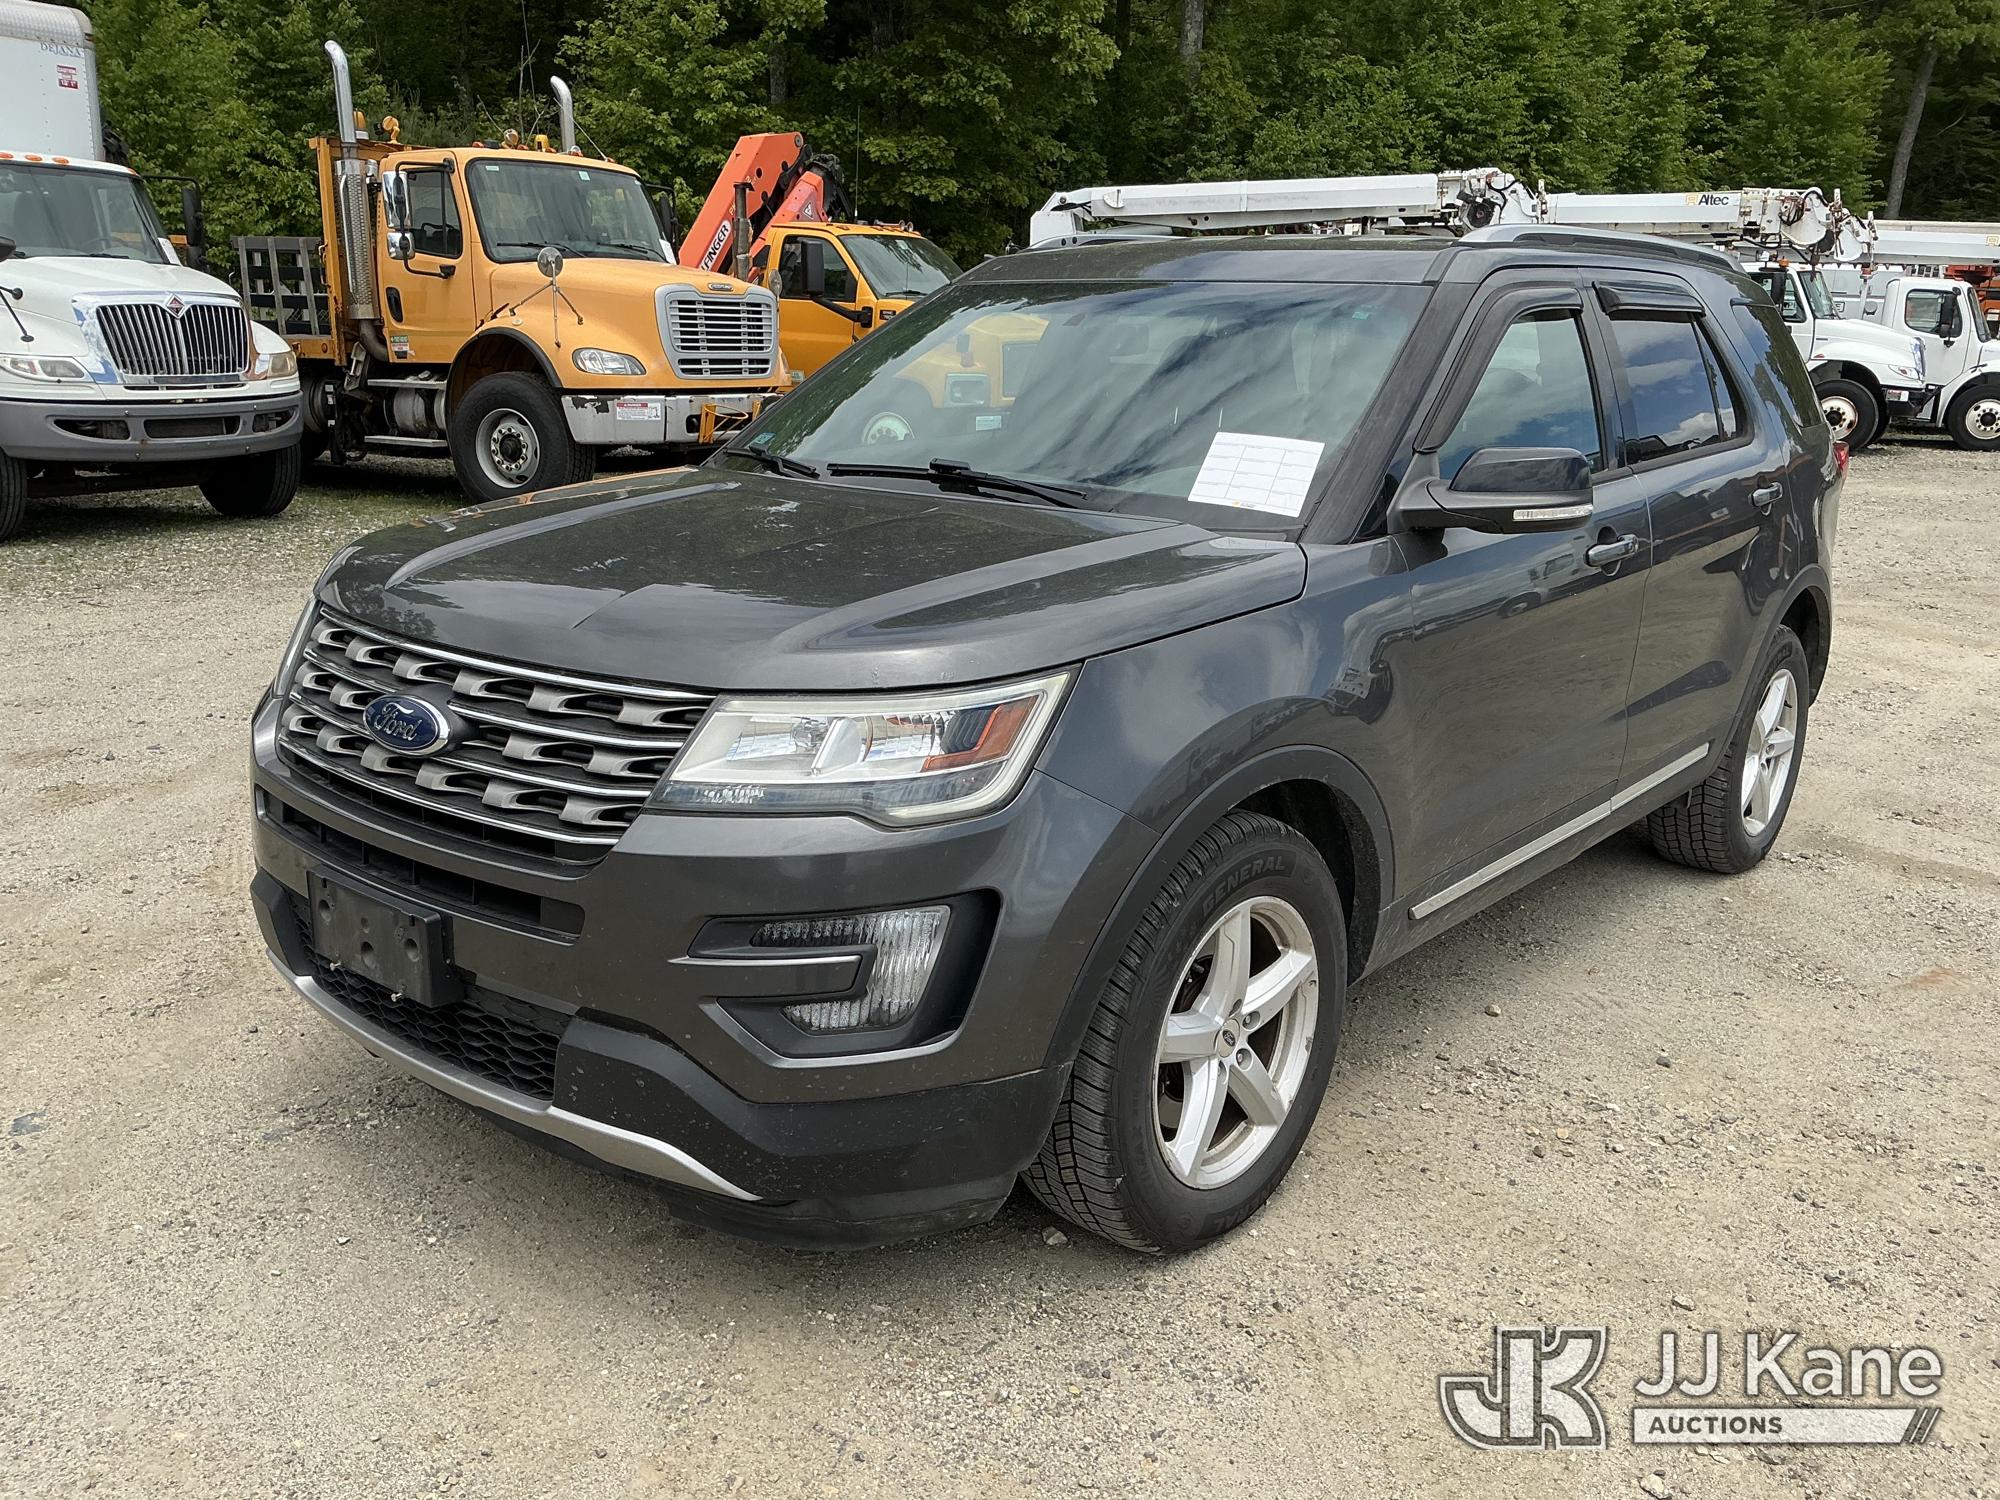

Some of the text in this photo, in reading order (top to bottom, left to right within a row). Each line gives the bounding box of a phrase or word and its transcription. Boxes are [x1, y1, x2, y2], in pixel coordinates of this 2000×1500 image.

[40, 42, 81, 58] DEJANA
[1698, 194, 1729, 206] Altec
[373, 702, 422, 741] Ford
[1202, 856, 1285, 917] GENERAL
